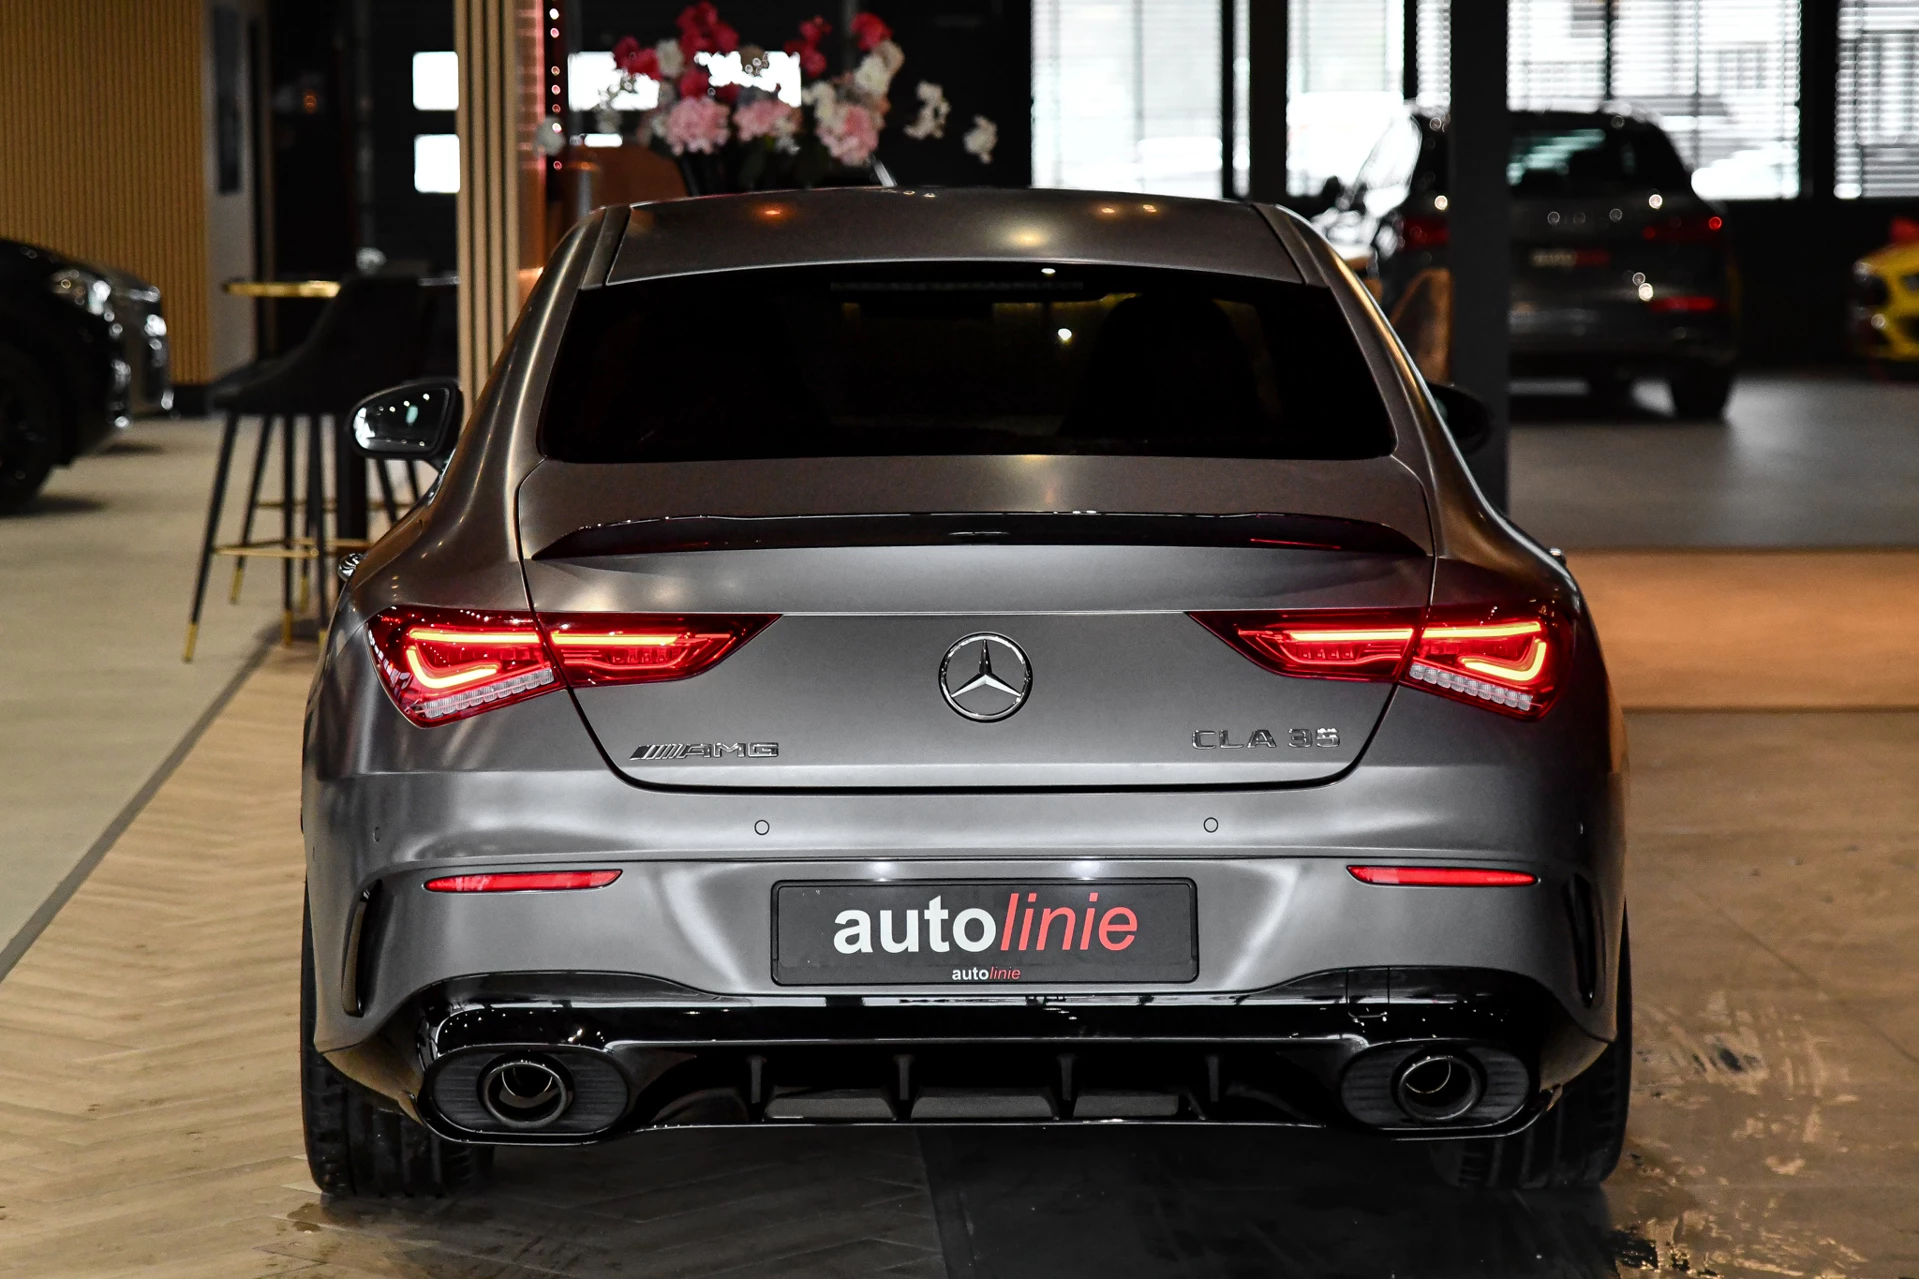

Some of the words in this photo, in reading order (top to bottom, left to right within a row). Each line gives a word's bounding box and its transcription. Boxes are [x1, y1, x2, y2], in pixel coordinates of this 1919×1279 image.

[1192, 729, 1277, 750] CLA
[1288, 728, 1341, 748] 35
[677, 742, 779, 759] AMG
[833, 892, 1138, 954] autolinie
[951, 966, 1021, 980] autolinie
